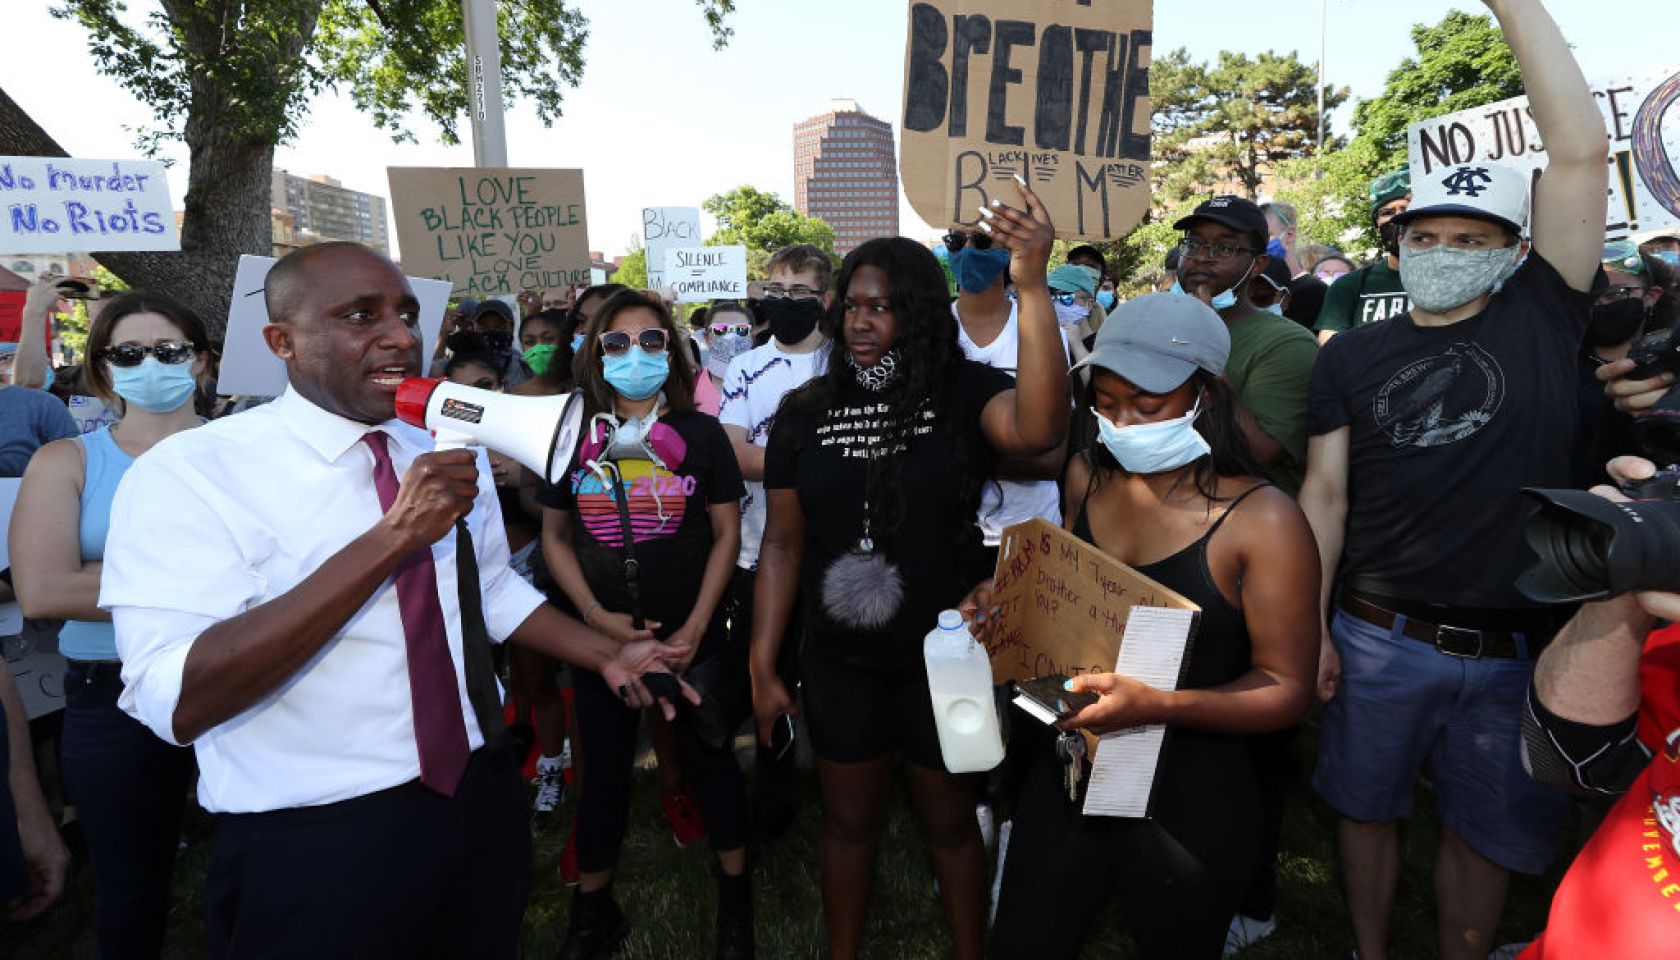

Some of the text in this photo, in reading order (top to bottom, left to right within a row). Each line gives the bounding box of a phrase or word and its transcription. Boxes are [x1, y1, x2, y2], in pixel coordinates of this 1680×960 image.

[1419, 122, 1475, 174] NO
[459, 176, 537, 206] LOVE
[8, 199, 165, 235] No Riots
[420, 205, 581, 232] BLACK PEOPLE
[438, 231, 556, 260] LIKE YOU
[472, 255, 542, 275] LOVE
[433, 268, 591, 294] LACK CULTURE
[670, 280, 741, 294] COMPLIANCE
[632, 475, 696, 496] 2020
